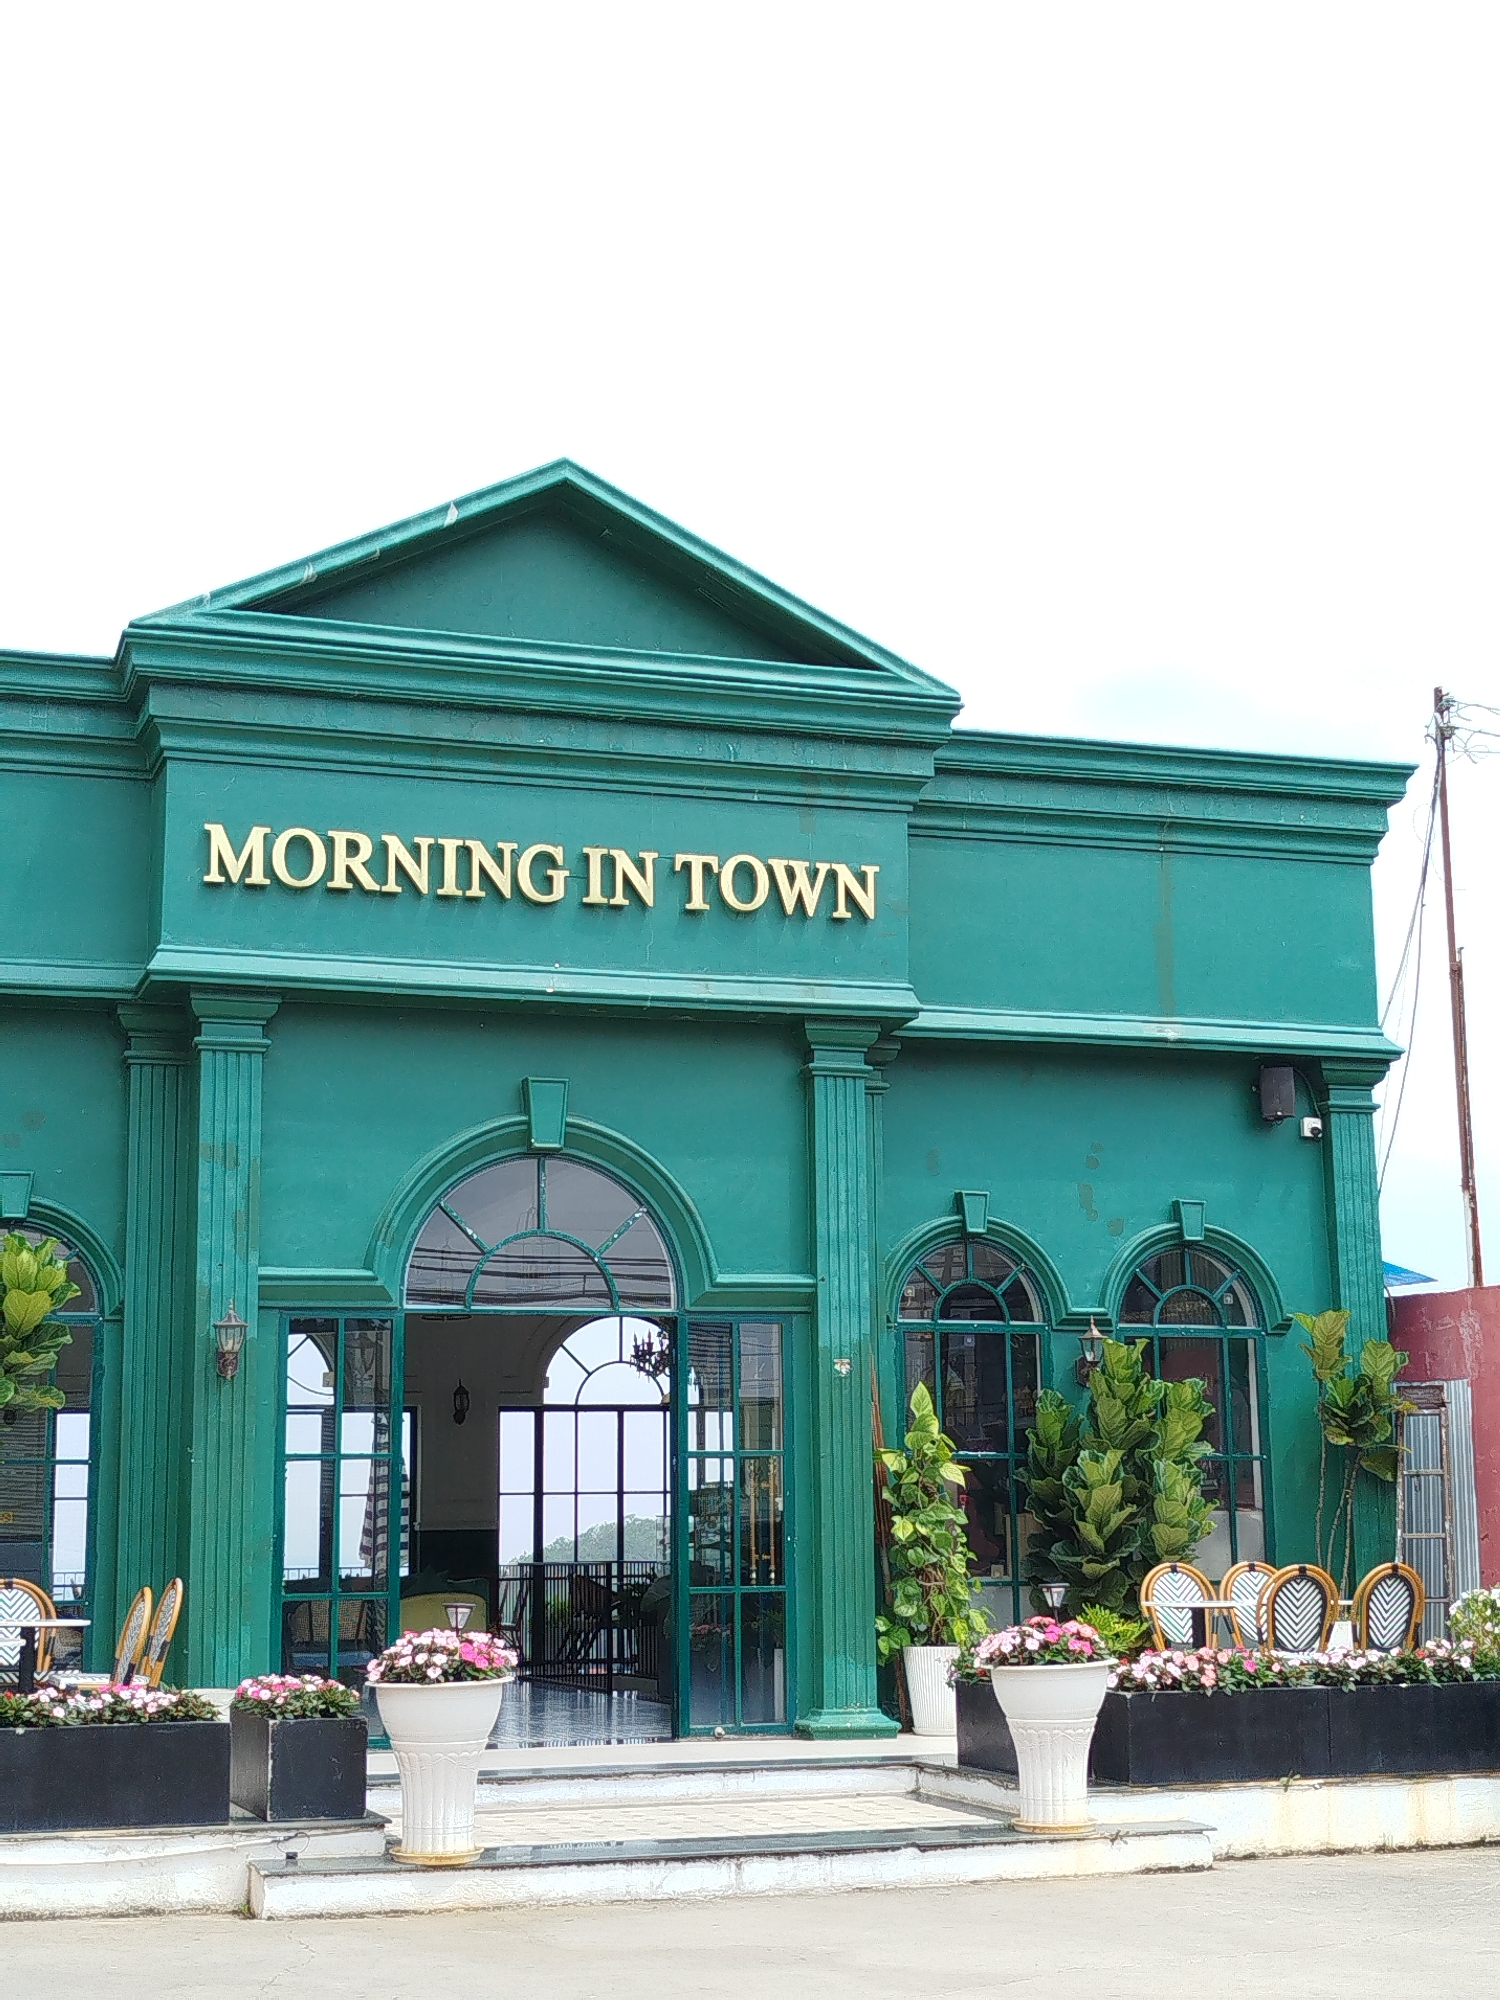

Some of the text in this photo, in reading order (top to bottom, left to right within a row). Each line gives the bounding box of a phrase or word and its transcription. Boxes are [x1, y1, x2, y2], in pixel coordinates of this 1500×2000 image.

[203, 822, 880, 920] MORNING IN TOWN
